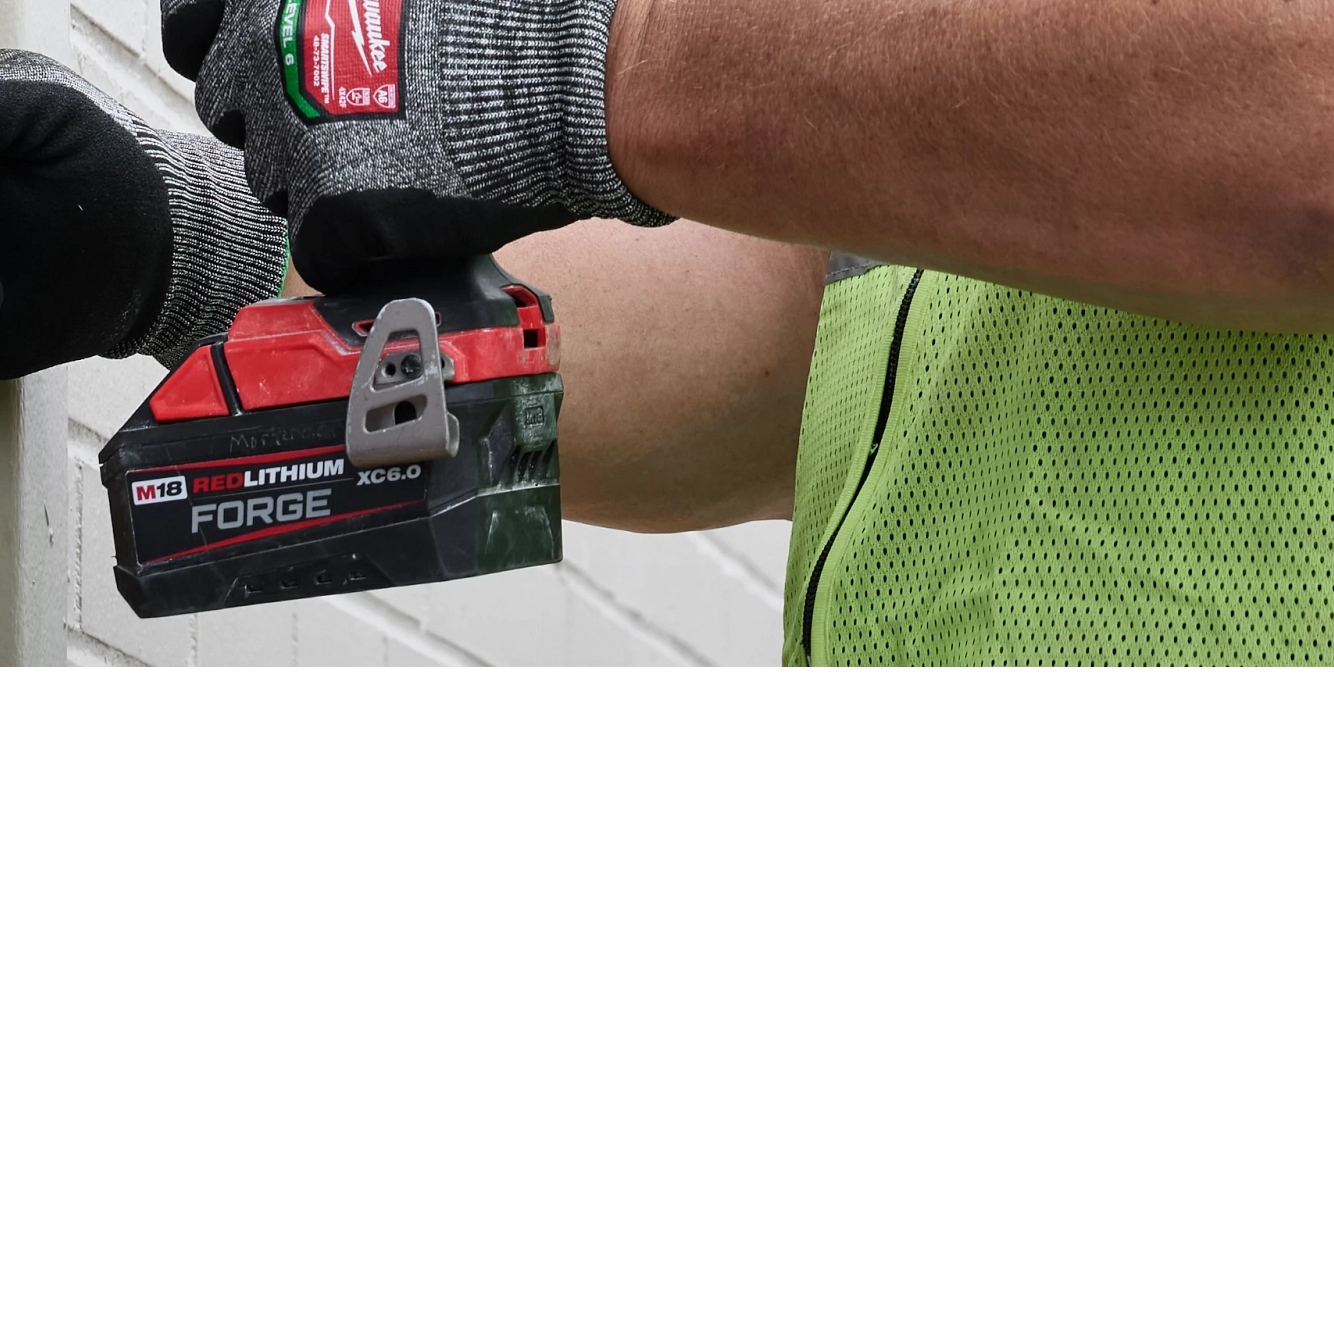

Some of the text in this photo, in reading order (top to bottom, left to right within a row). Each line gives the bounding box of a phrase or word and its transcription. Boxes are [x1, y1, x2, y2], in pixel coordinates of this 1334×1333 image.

[285, 54, 295, 65] 6
[378, 90, 388, 103] A6
[192, 458, 345, 494] REDLITHIUM
[357, 464, 422, 486] XC6.0
[136, 482, 183, 501] M18
[191, 489, 332, 533] FORGE
